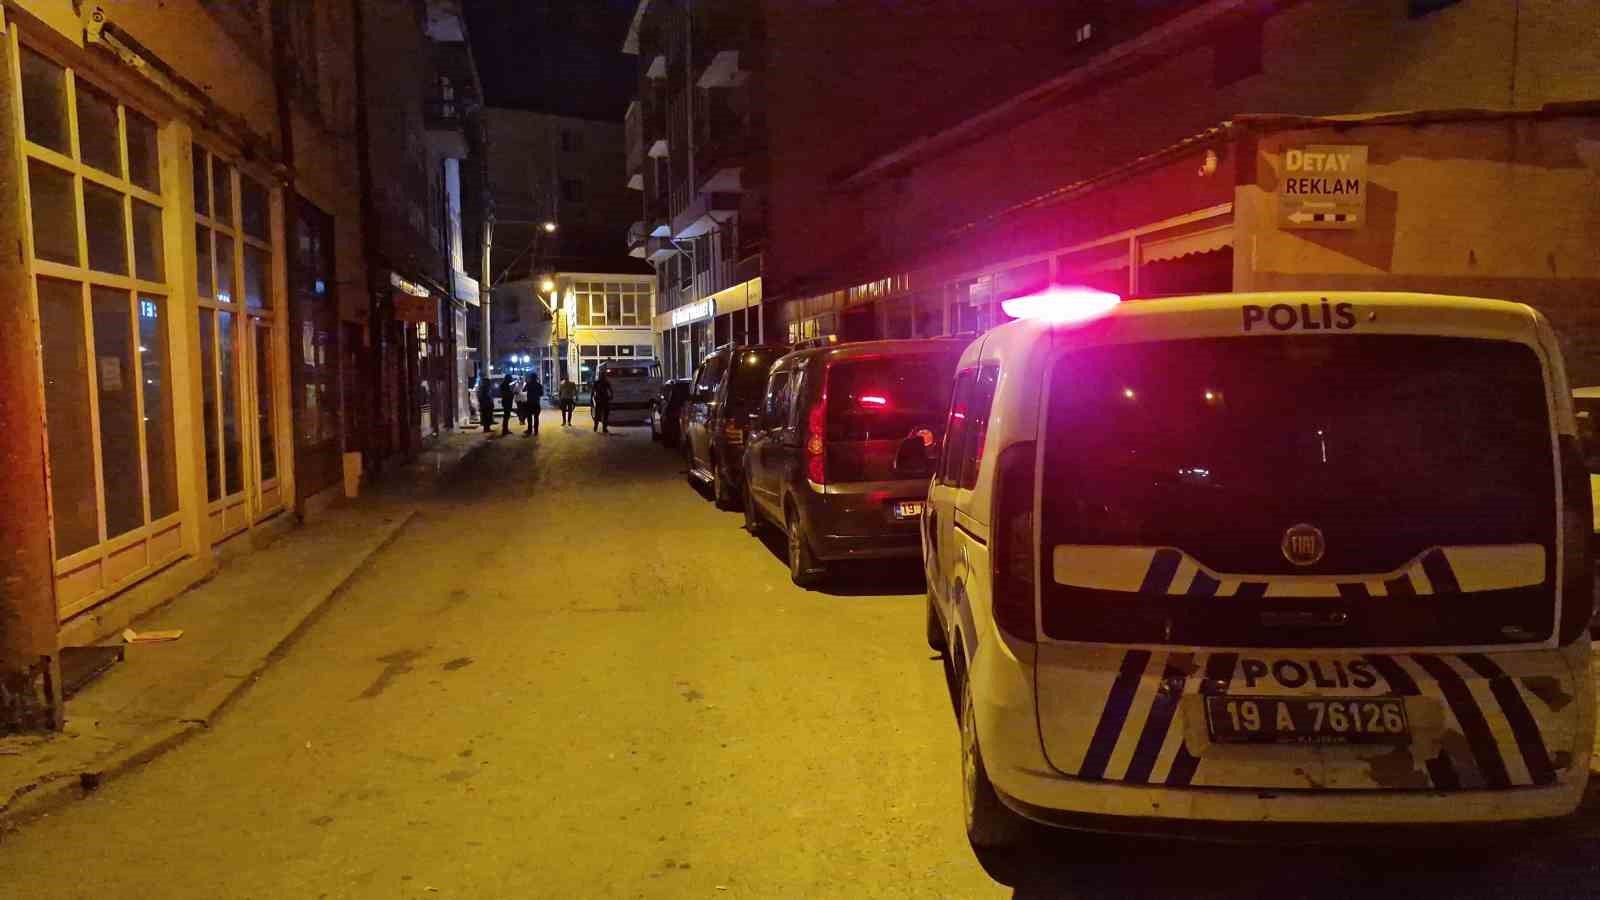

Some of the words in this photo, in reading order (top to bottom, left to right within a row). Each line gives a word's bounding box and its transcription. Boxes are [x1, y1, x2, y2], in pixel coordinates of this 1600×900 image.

[1286, 150, 1351, 171] DETAY
[1286, 178, 1359, 194] REKLAM
[1227, 702, 1261, 731] 19
[1276, 702, 1296, 731] A
[1308, 702, 1402, 732] 76126
